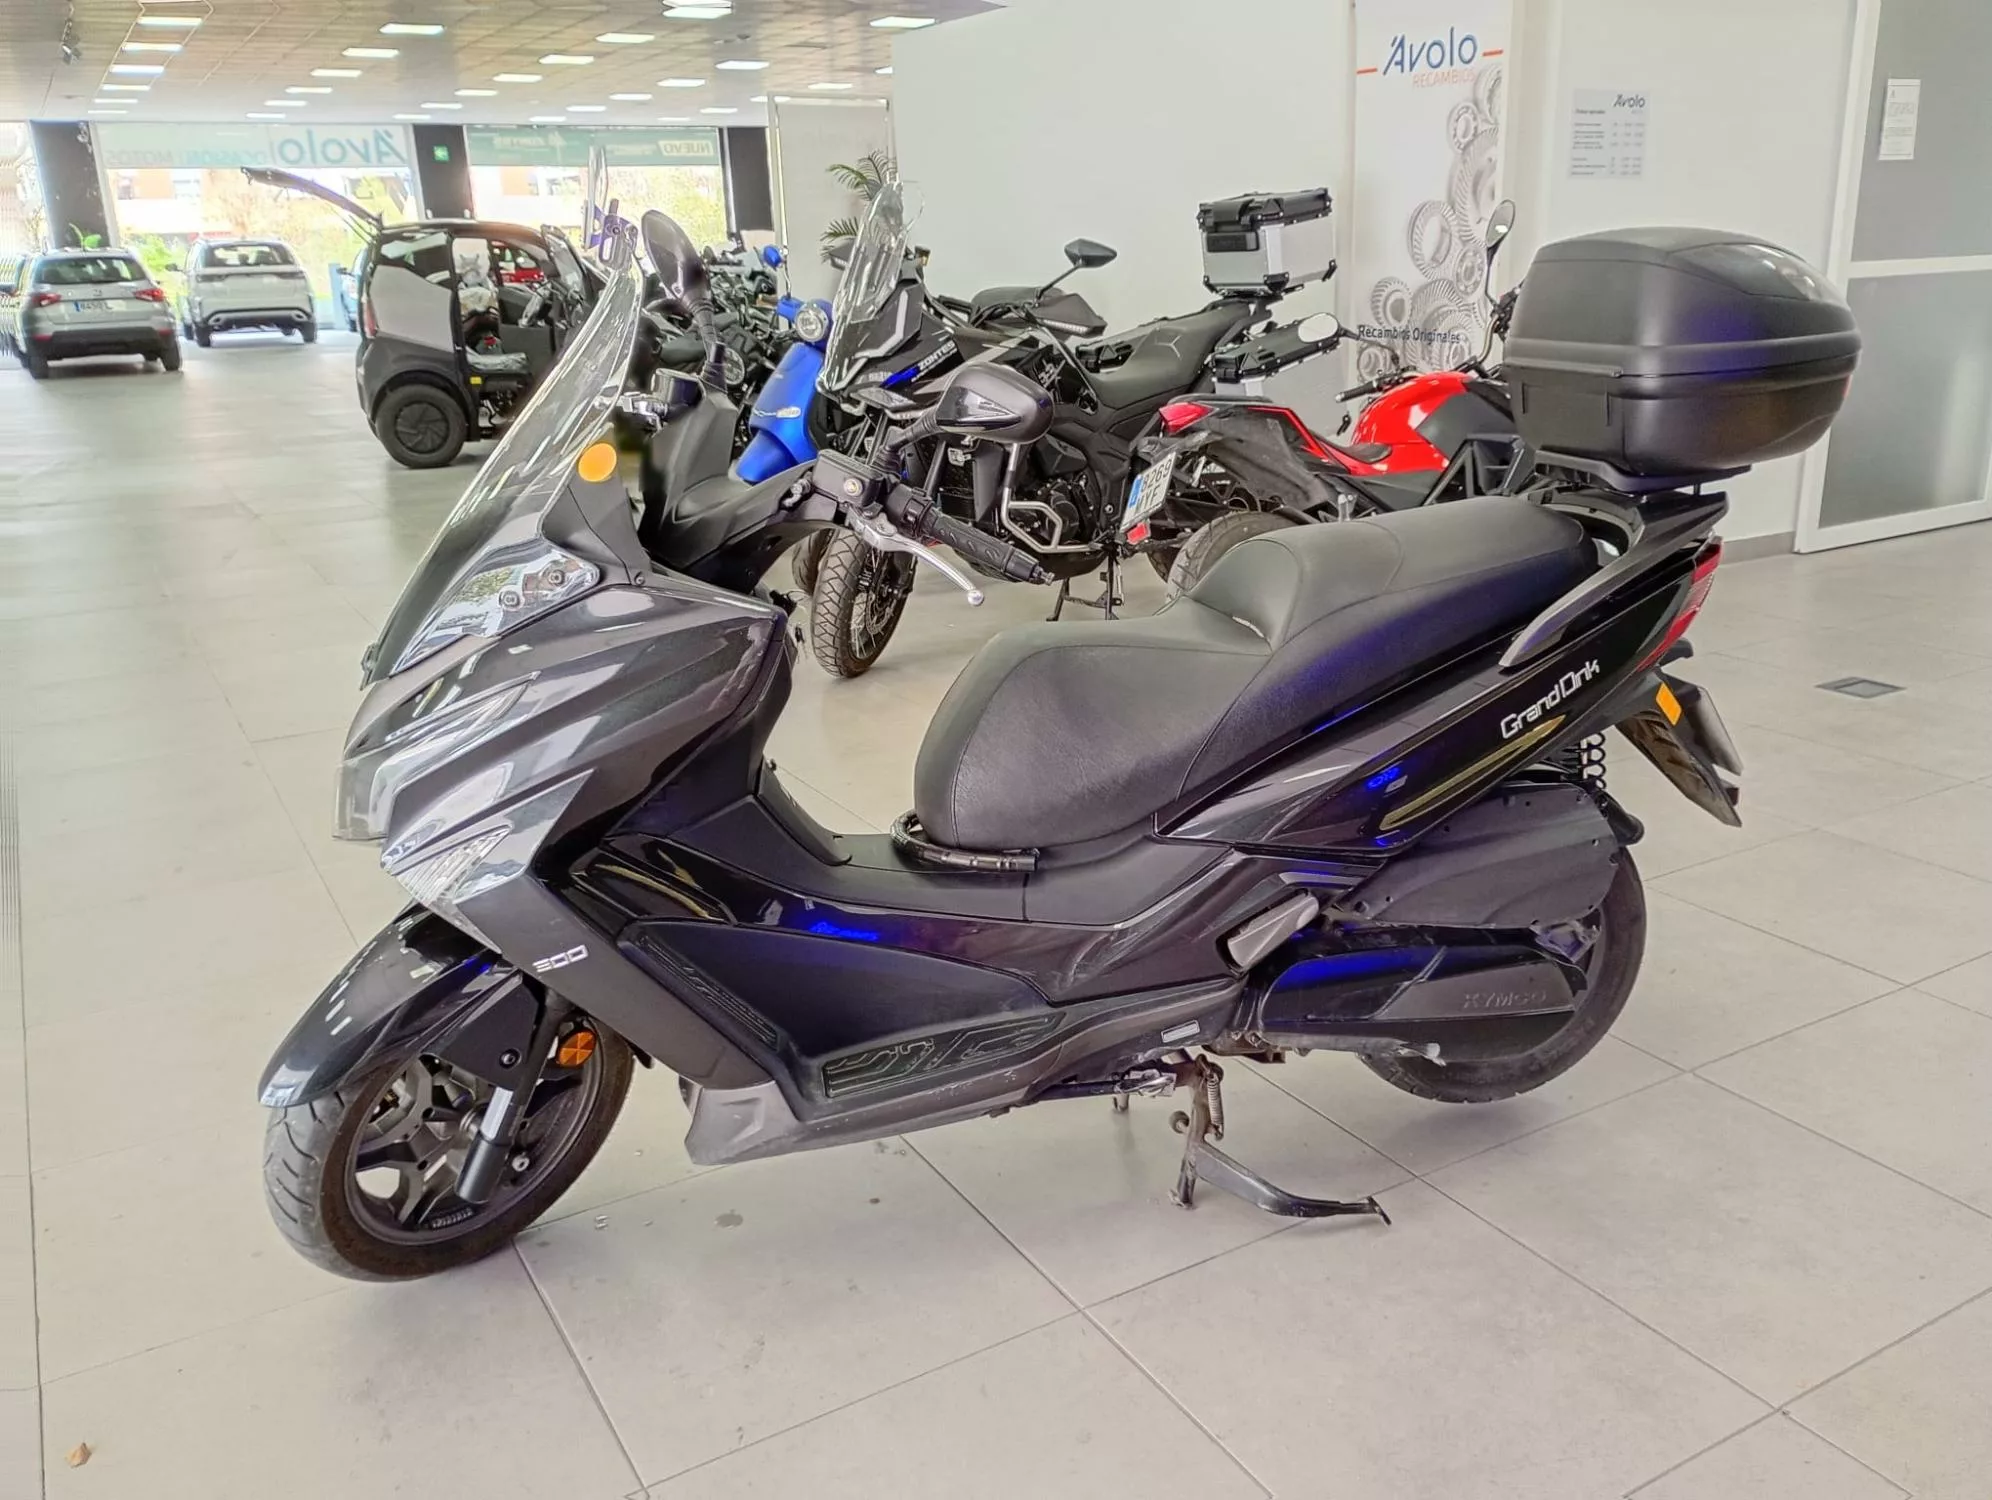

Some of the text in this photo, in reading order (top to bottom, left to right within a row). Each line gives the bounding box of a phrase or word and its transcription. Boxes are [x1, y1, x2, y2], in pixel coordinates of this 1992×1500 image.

[1412, 68, 1476, 88] RECAMBIOS
[1357, 324, 1461, 345] Recambios Originales
[917, 341, 956, 371] ZONTES
[1501, 684, 1560, 738] Grand
